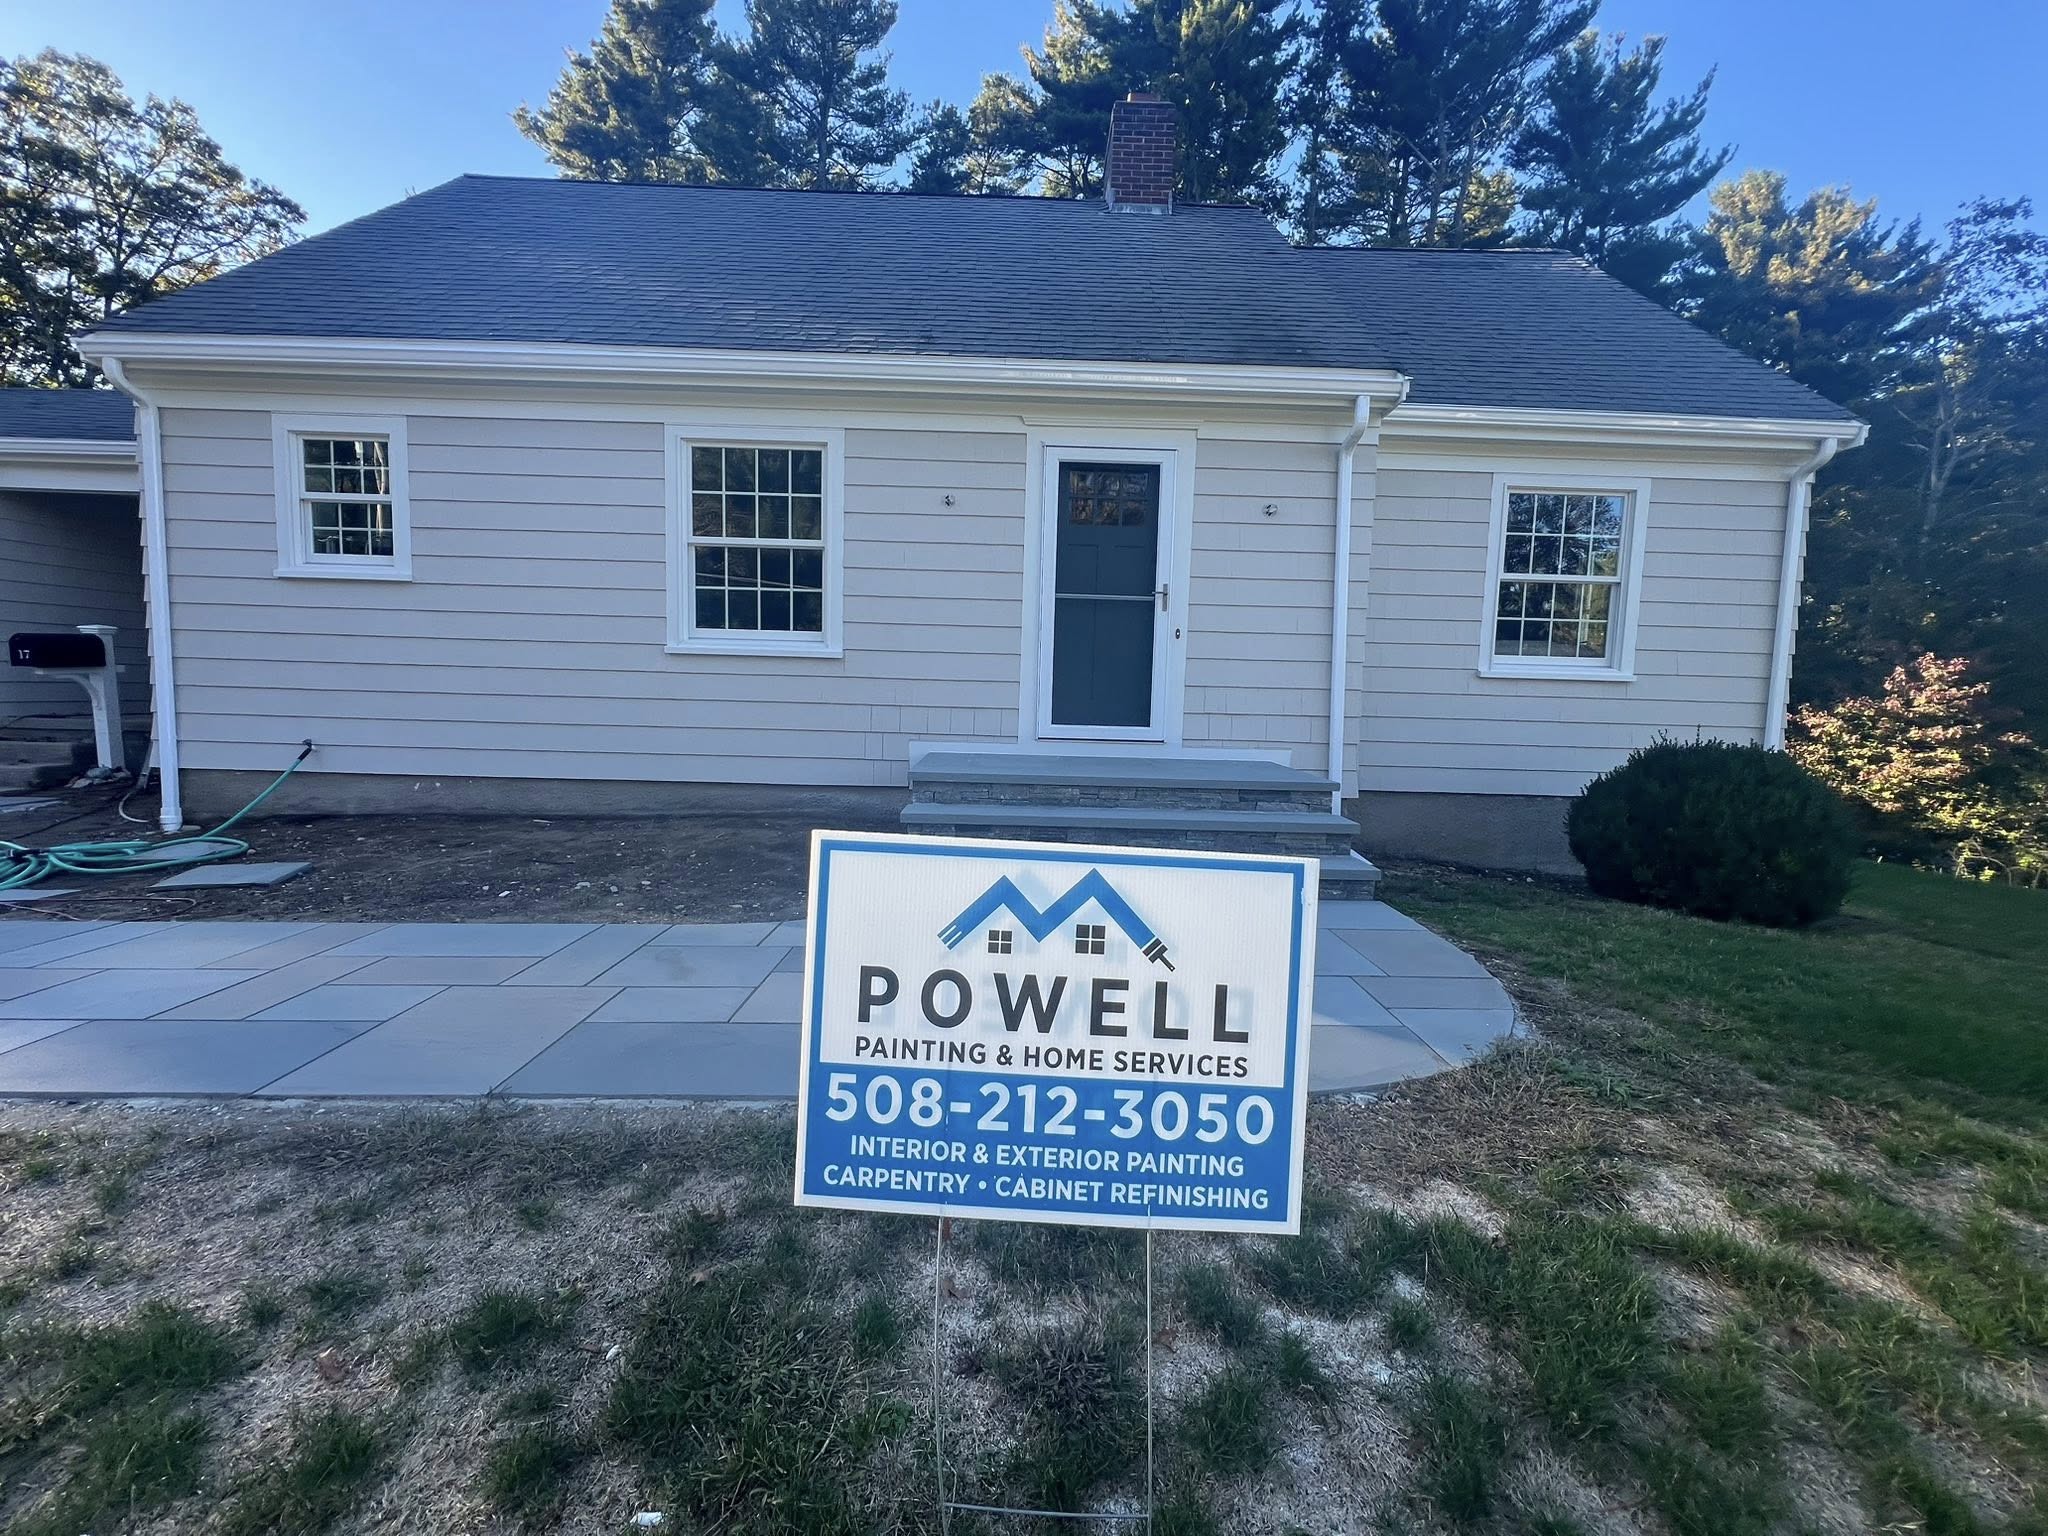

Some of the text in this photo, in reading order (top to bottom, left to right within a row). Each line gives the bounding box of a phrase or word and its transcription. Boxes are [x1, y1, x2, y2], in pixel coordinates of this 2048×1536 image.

[18, 649, 30, 659] 17
[857, 965, 1249, 1043] POWELL
[855, 1035, 1249, 1078] PAINTING & HOME SERVICES
[825, 1073, 1274, 1145] 508-212-3050
[850, 1134, 1244, 1177] INTERIOR & EXTERIOR PAINTING
[823, 1165, 1269, 1210] CARPENTRY CABINET REFINISHING
